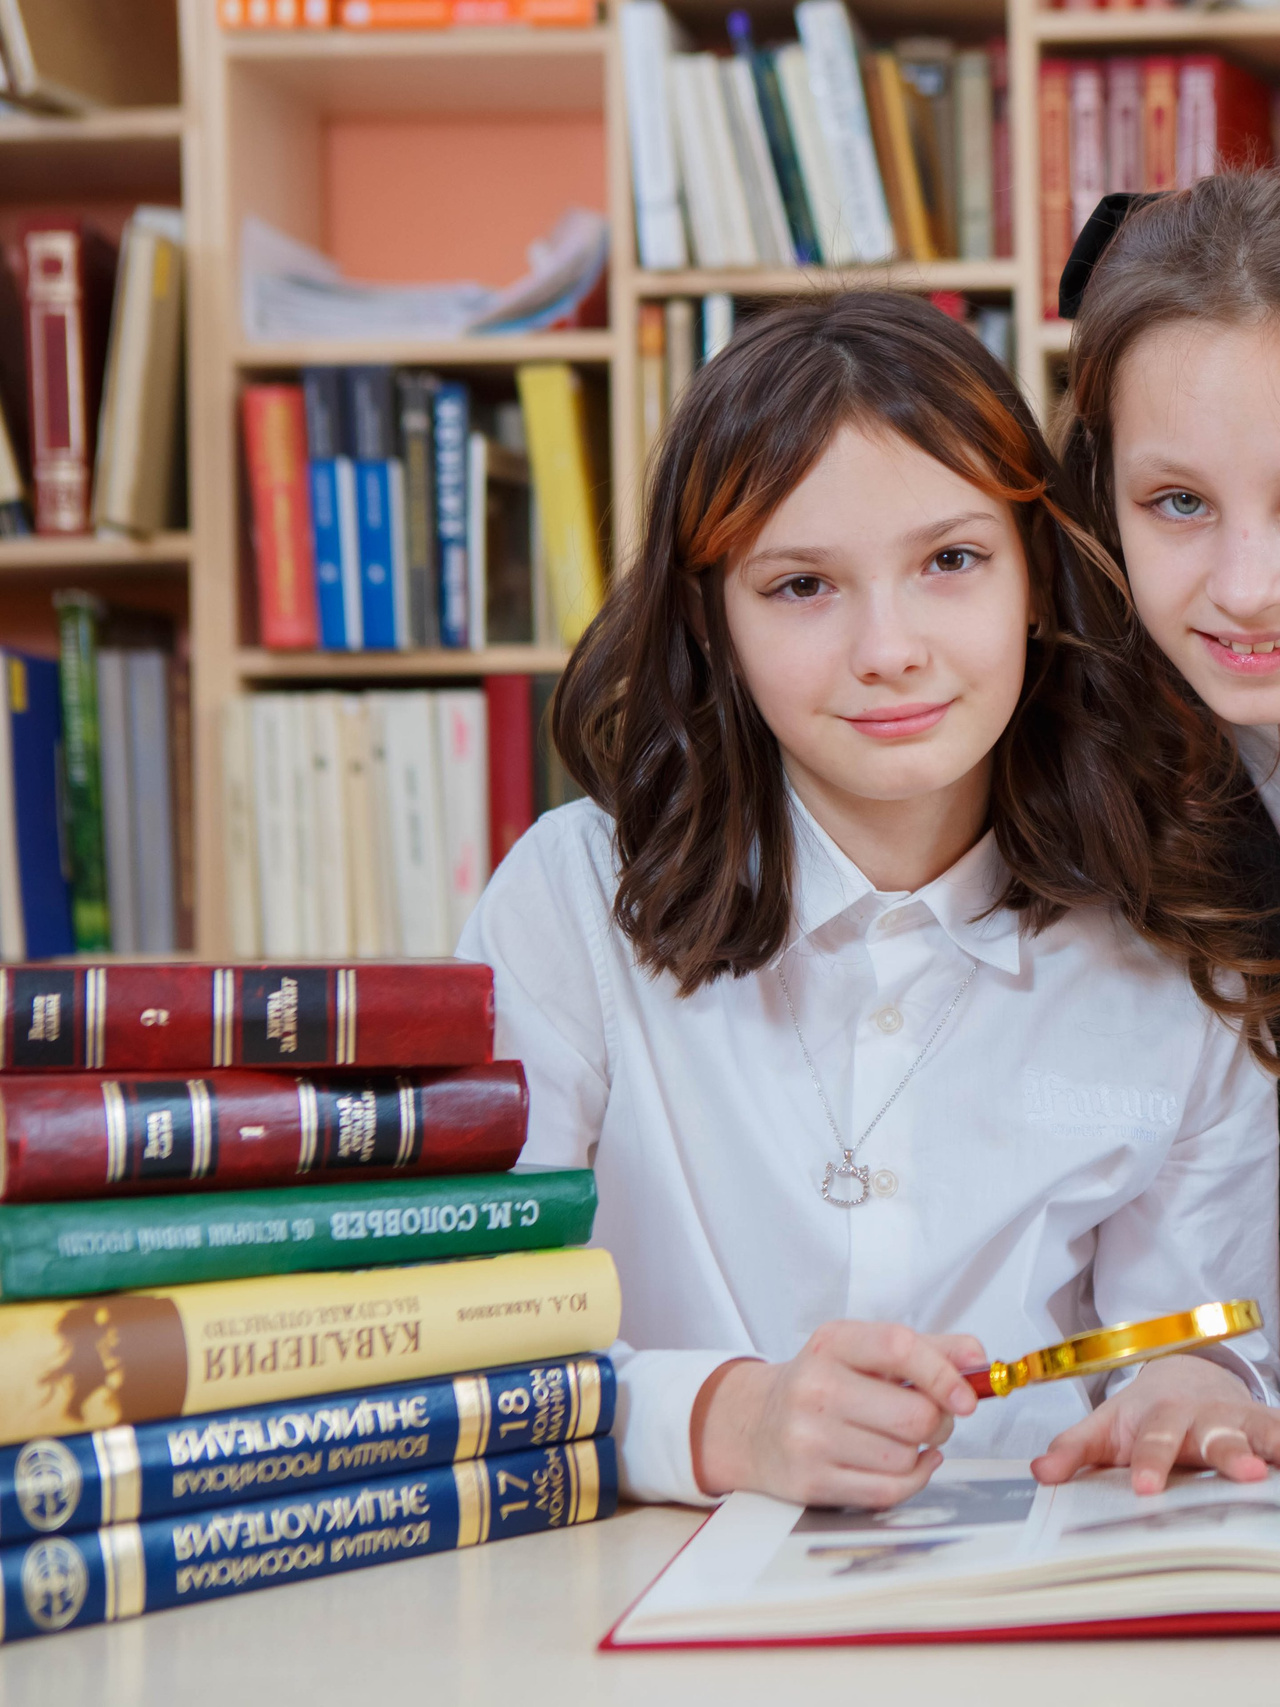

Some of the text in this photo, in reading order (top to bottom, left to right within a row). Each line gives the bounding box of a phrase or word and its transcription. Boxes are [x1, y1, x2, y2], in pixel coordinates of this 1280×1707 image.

[140, 1008, 169, 1027] 2
[1022, 1065, 1178, 1127] Future
[239, 1126, 265, 1140] 1
[330, 1203, 479, 1241] СОЛОВЬЕВ
[202, 1320, 422, 1384] КАВАЛЕРИЯ
[167, 1396, 431, 1467] ЭНЦИКЛОПЕДИЯ
[497, 1387, 531, 1440] 18
[529, 1368, 550, 1445] ЛОМОН
[172, 1434, 430, 1498] БОЛЬШАЯ РОССИЙСКАЯ
[496, 1469, 530, 1521] 17
[532, 1469, 549, 1511] ЛАС
[172, 1483, 431, 1562] ЭНЦИКЛОПЕДИЯ
[175, 1520, 431, 1595] БОЛЬШАЯ РОССИЙСКАЯ
